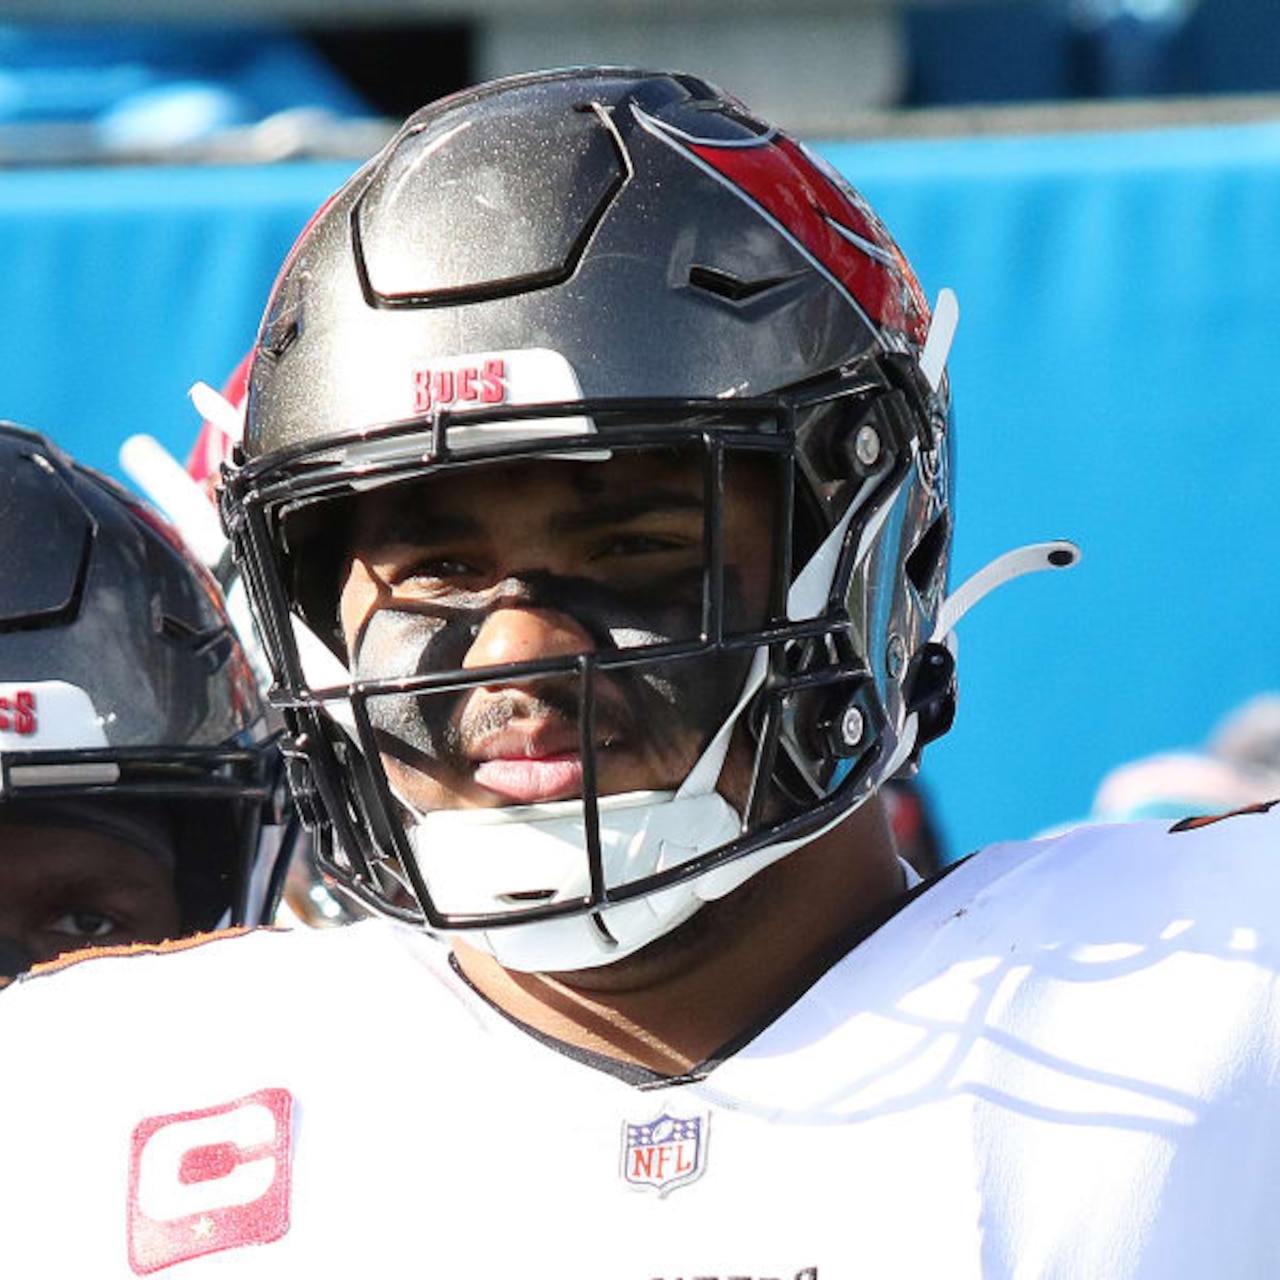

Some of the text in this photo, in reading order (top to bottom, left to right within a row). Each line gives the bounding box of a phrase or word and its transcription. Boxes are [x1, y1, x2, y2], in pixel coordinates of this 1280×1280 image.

[413, 359, 505, 413] BUCS
[138, 1103, 277, 1223] C
[631, 1145, 691, 1178] NFL
